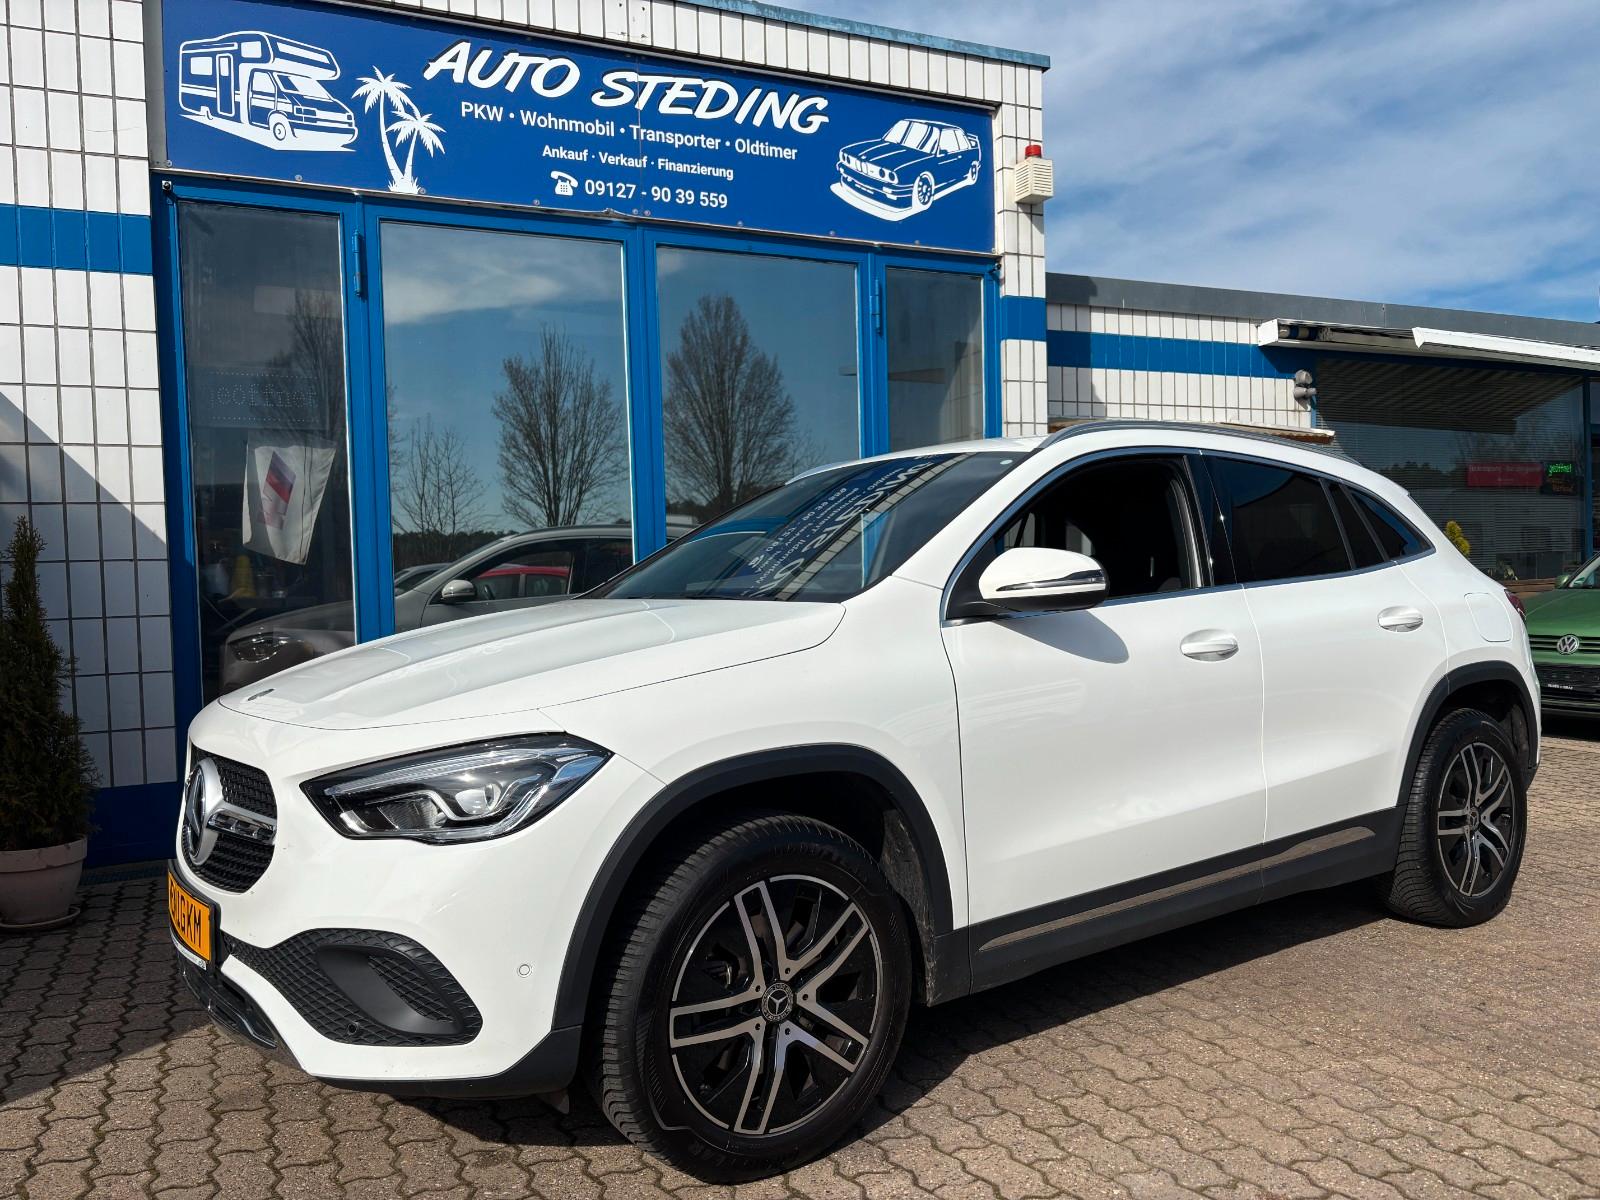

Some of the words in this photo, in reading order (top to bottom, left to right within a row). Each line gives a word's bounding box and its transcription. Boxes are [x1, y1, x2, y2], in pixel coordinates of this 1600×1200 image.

[424, 41, 580, 98] AUTO
[591, 71, 829, 134] STEDING
[461, 102, 504, 122] PKW
[520, 109, 615, 137] Wohnmobil
[629, 123, 721, 150] Transporter
[734, 138, 798, 160] Oldtimer
[542, 145, 588, 162] Ankauf
[599, 151, 648, 168] Verkauf
[657, 158, 734, 180] Finanzierung
[584, 179, 636, 199] 09127
[651, 186, 672, 202] 90
[675, 188, 695, 204] 39
[699, 191, 728, 209] 559
